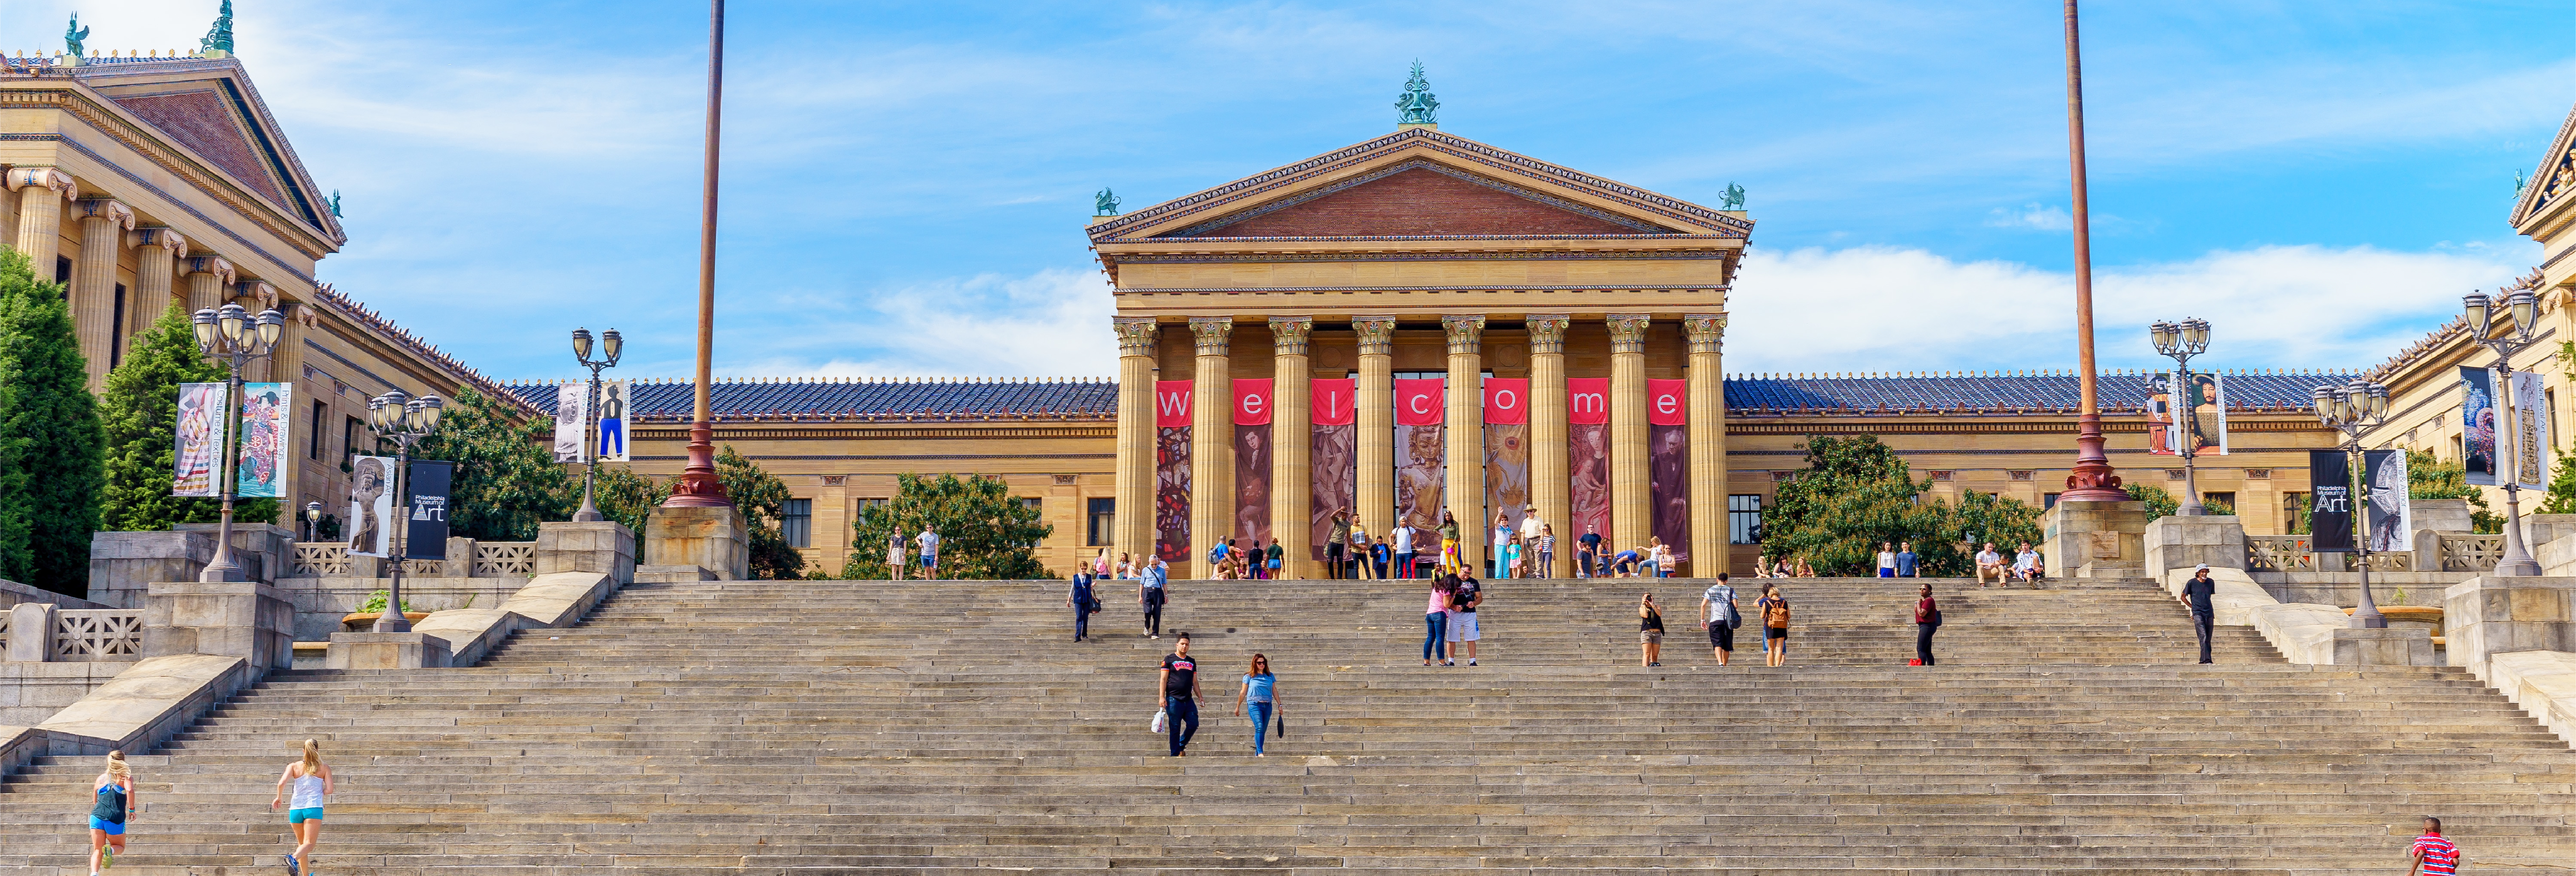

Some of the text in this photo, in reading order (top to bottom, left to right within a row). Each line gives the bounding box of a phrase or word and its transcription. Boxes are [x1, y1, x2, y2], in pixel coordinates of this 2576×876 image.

[214, 390, 225, 425] Costume
[578, 388, 588, 425] Photography
[212, 437, 221, 467] Textiles
[278, 422, 288, 460] Drawings
[412, 504, 444, 521] Art
[2314, 495, 2347, 512] Art
